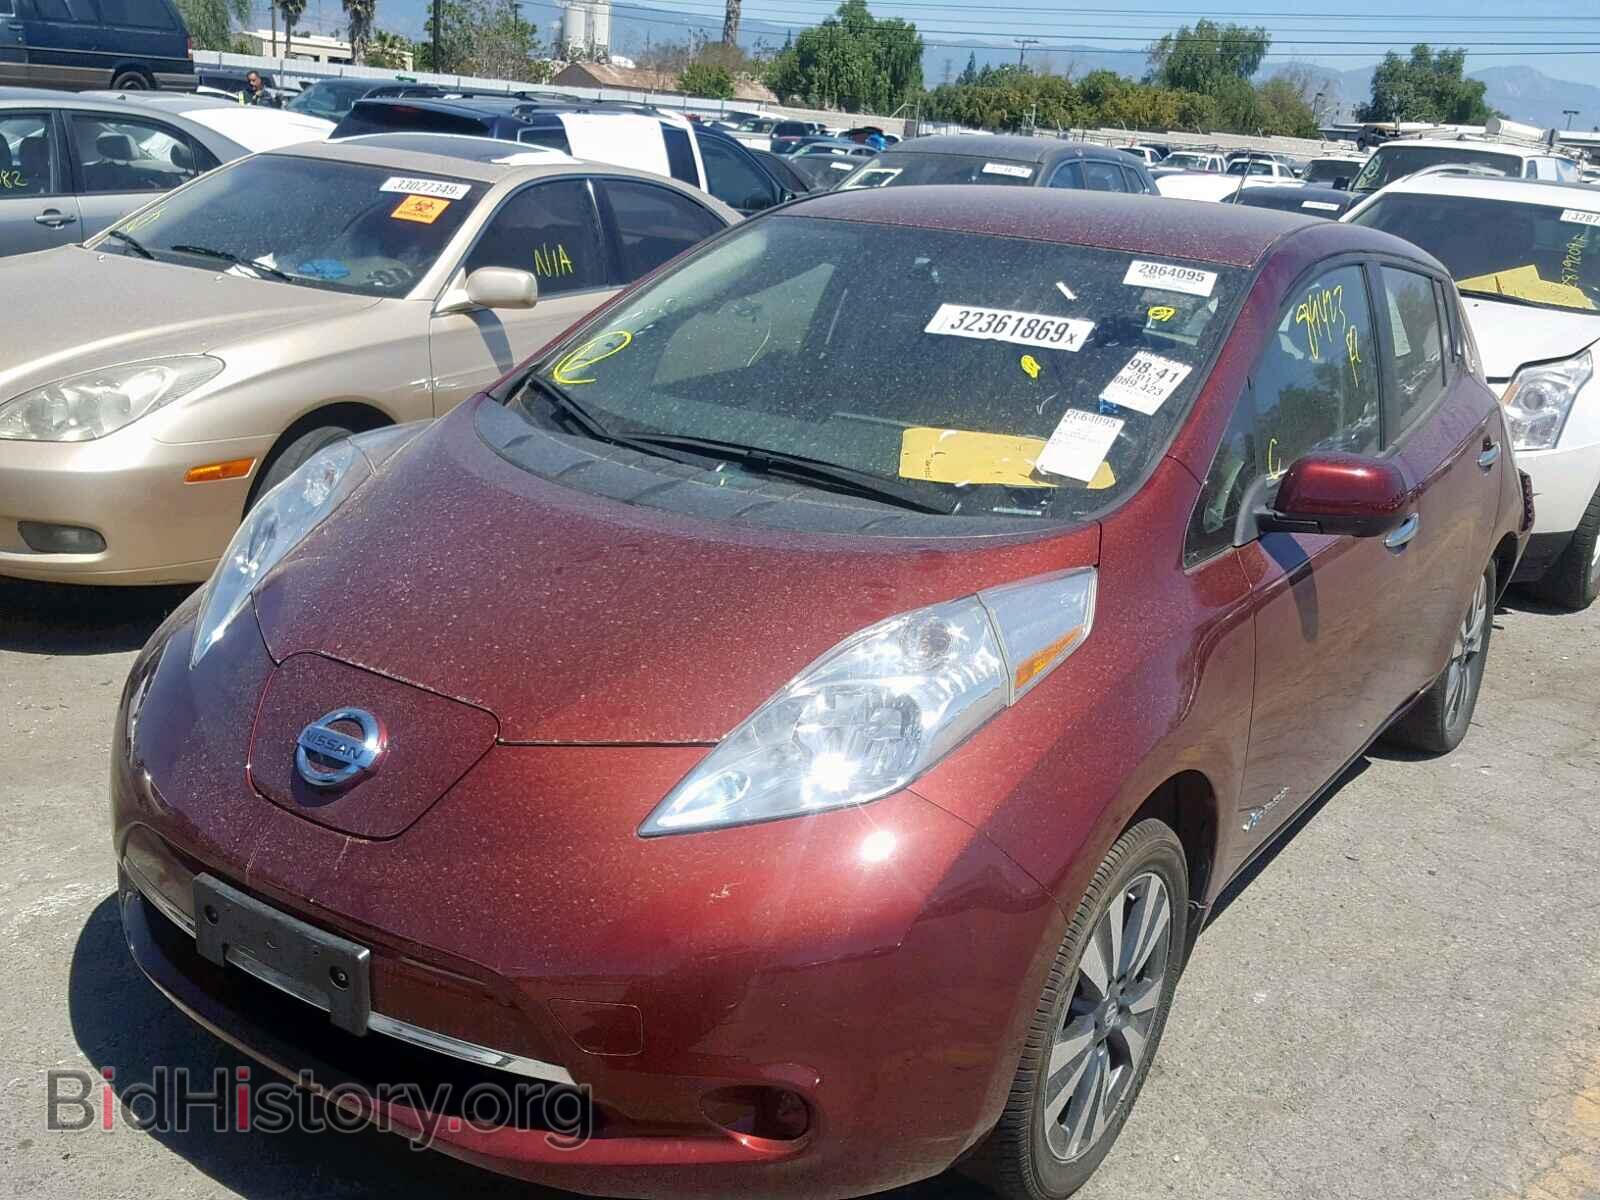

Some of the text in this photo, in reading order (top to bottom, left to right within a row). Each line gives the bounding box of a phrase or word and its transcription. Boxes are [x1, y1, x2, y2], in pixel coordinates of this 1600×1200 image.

[0, 169, 29, 189] 82
[393, 179, 460, 196] 33027349
[1571, 212, 1600, 224] 3287
[1138, 263, 1207, 283] 2864095
[305, 729, 364, 761] NISSAN
